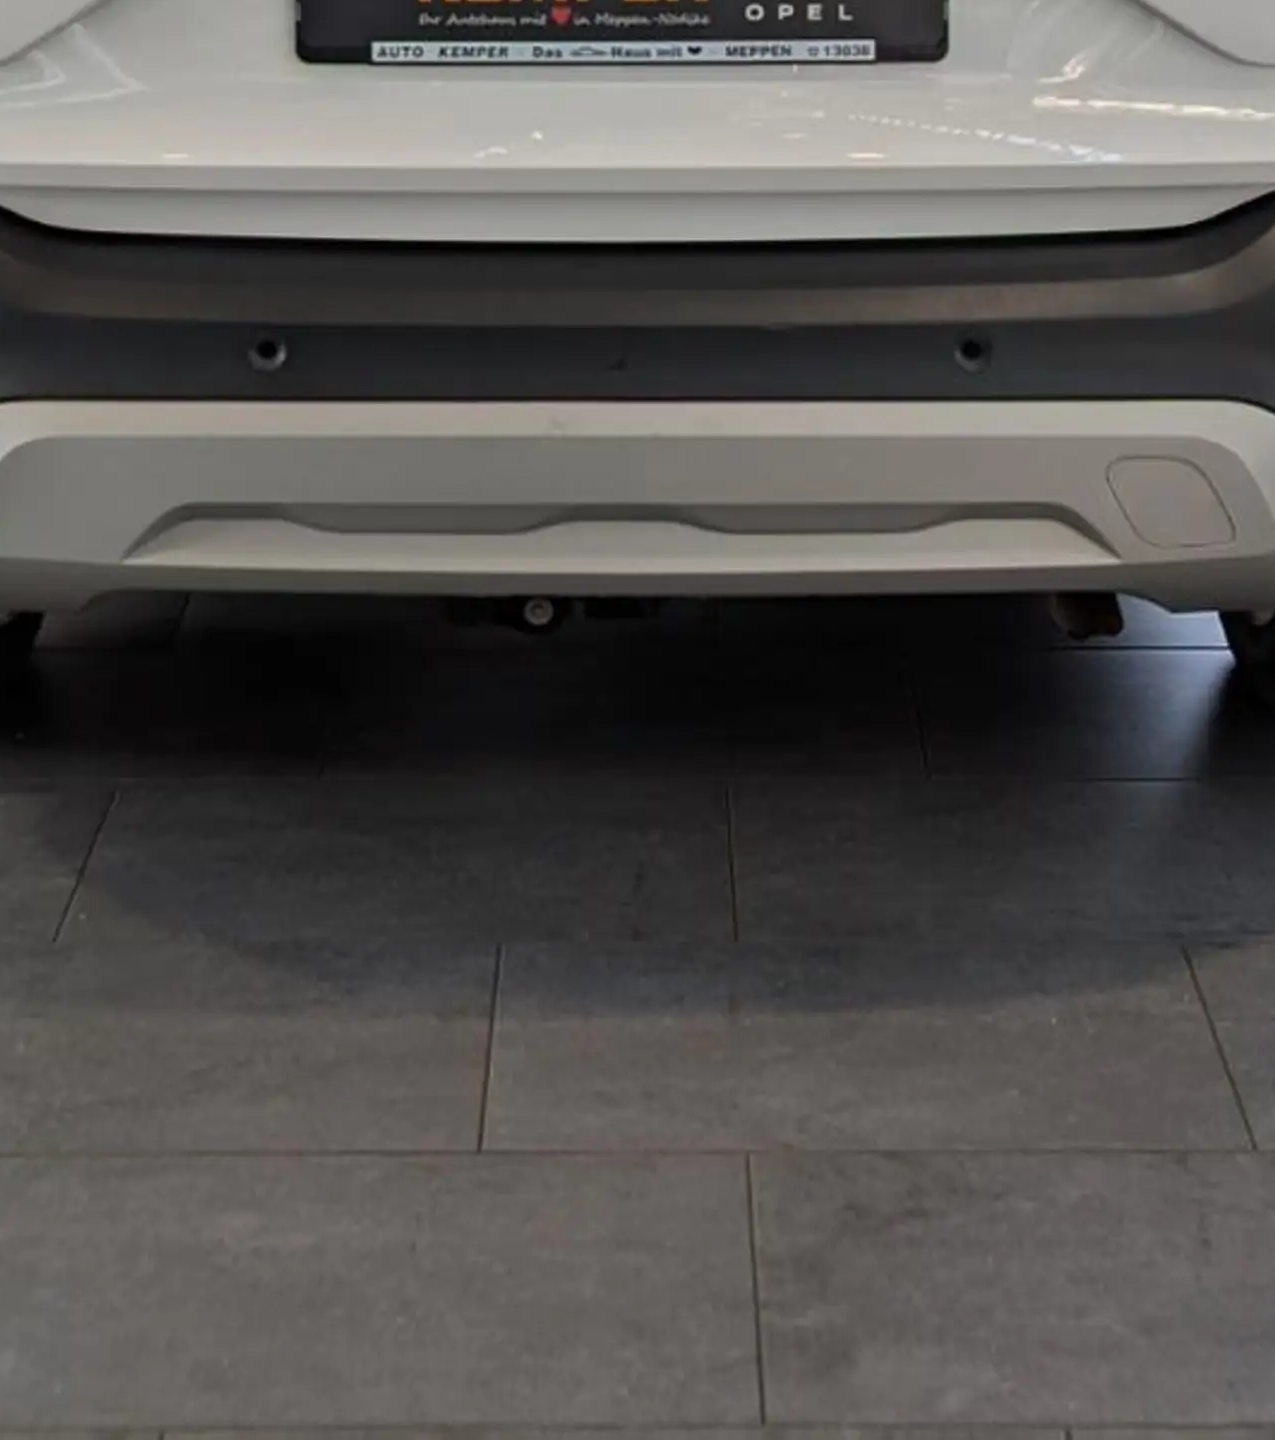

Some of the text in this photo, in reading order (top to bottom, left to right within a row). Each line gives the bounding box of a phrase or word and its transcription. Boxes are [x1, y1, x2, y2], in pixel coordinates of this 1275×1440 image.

[744, 3, 853, 21] OPEL
[377, 45, 424, 58] AUTO
[437, 45, 509, 58] KEMPER
[532, 45, 563, 58] Das
[726, 45, 792, 57] MEPPEN
